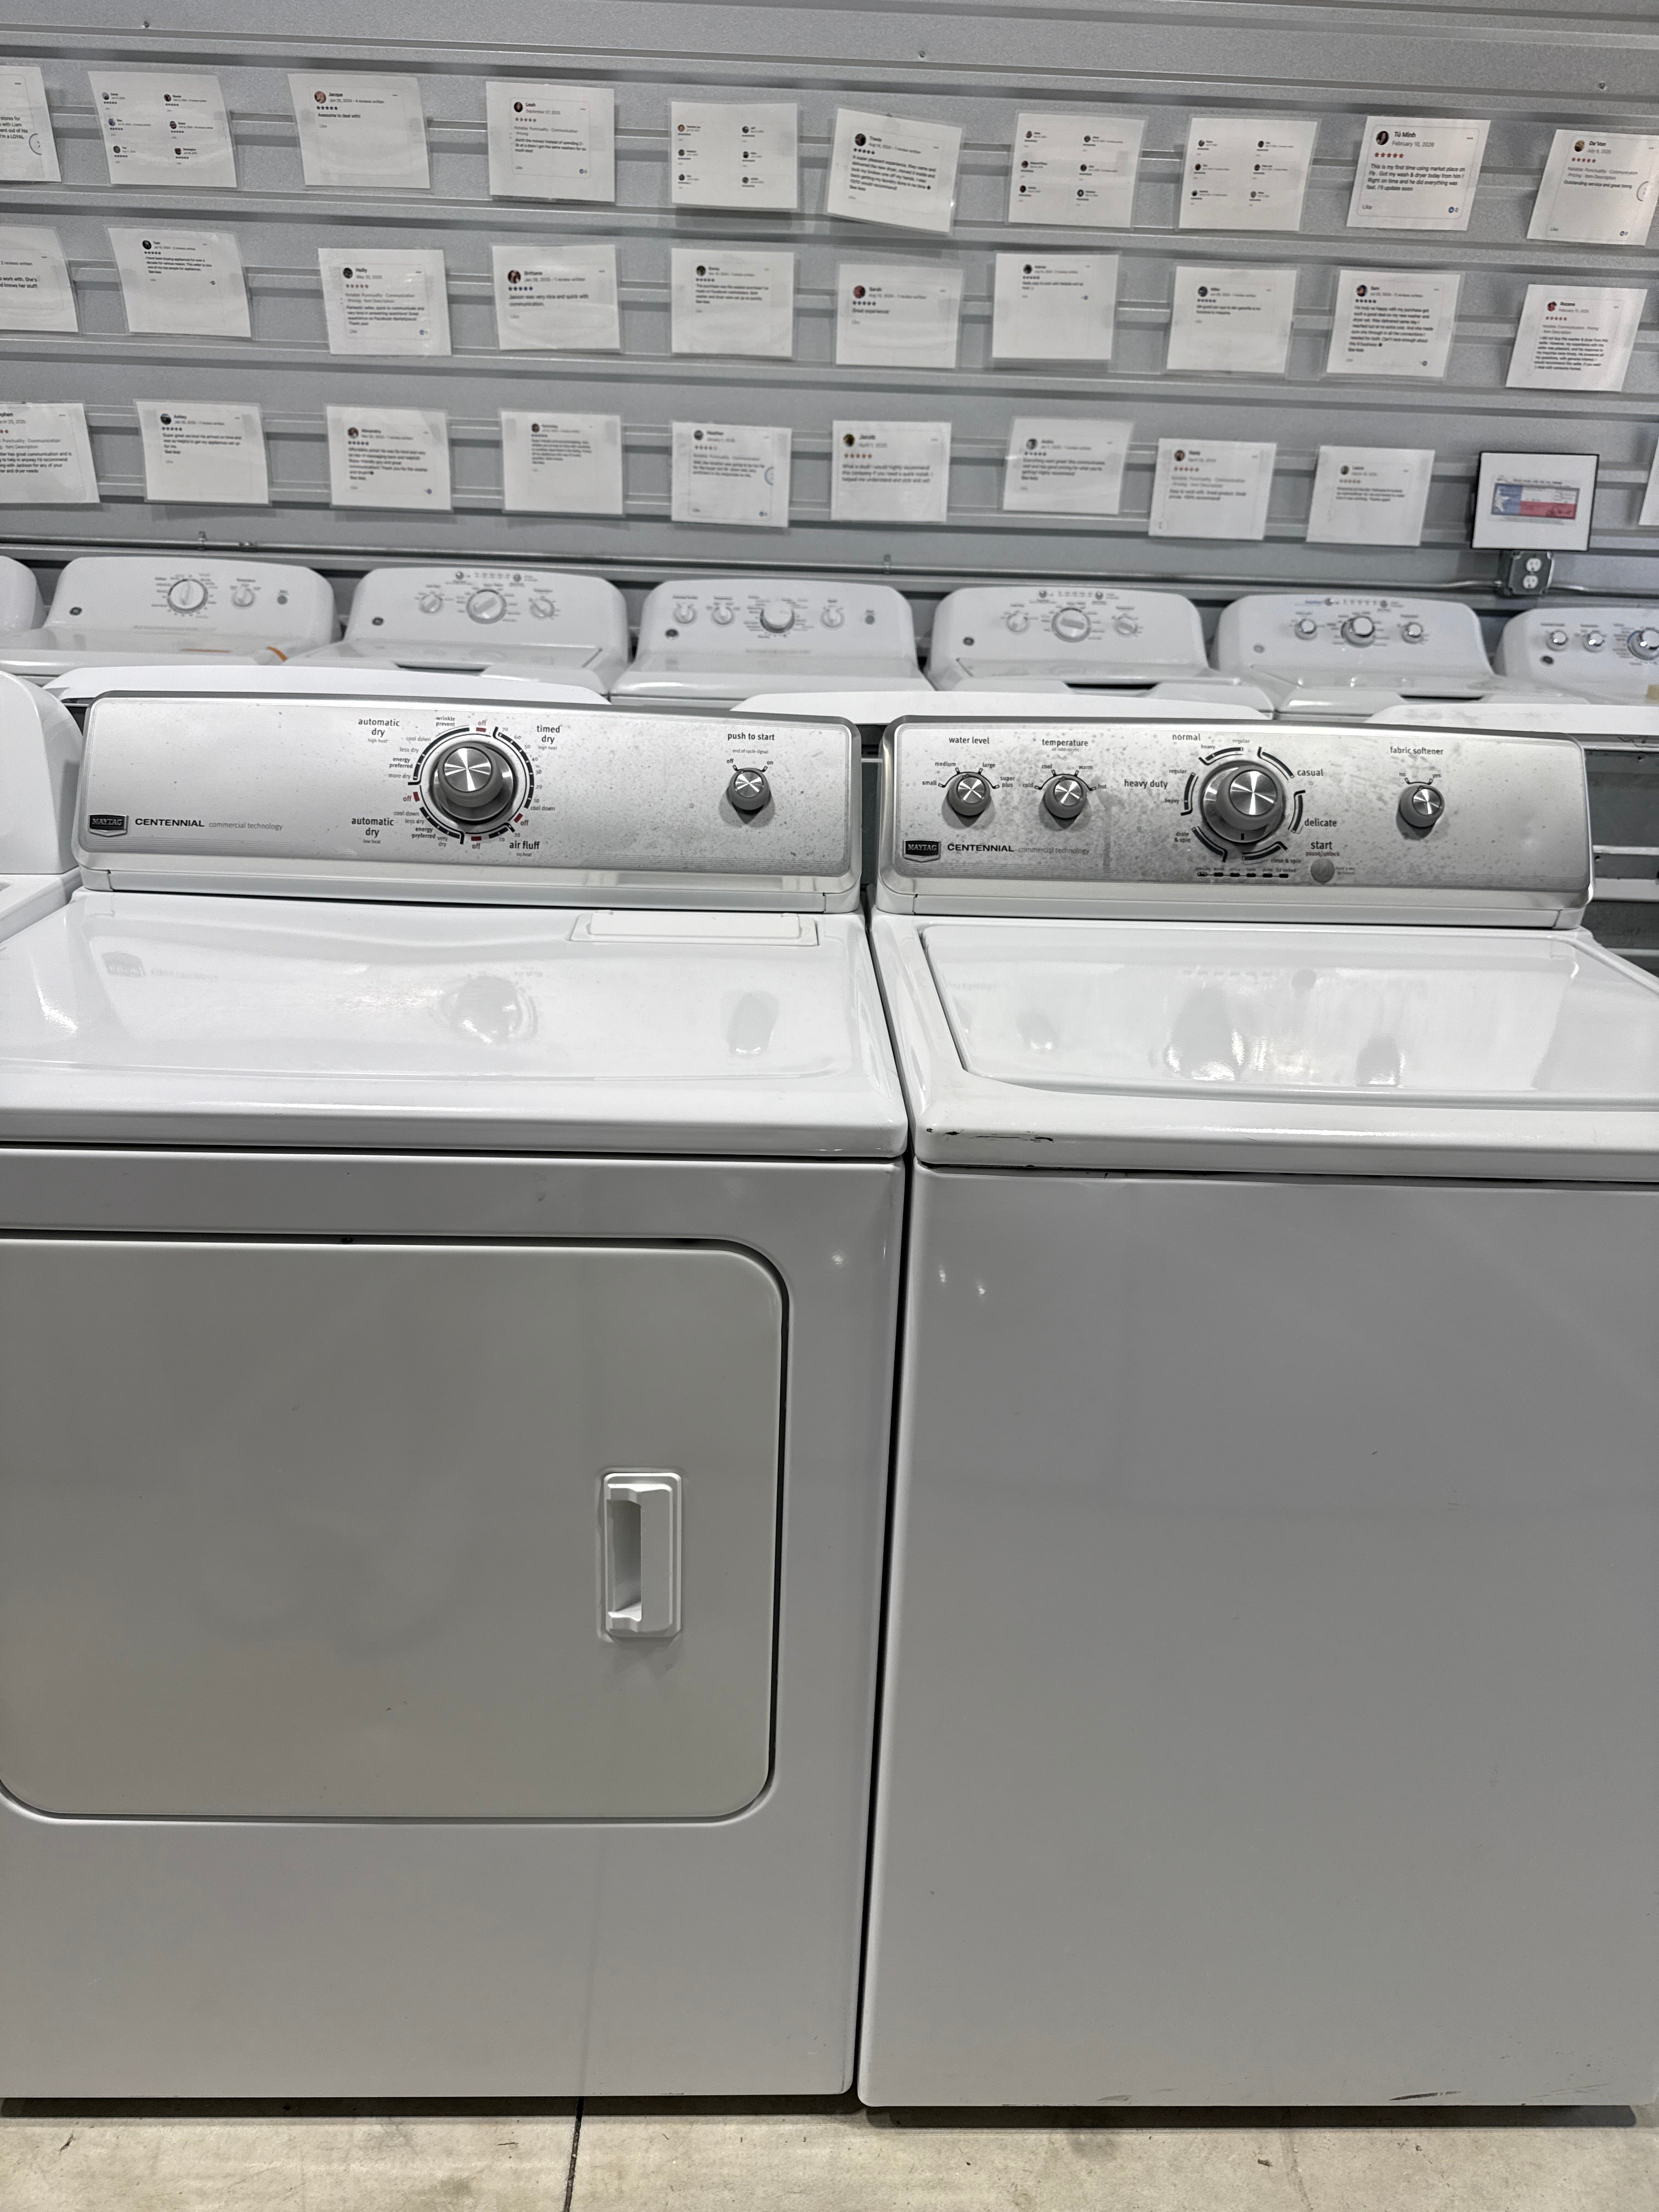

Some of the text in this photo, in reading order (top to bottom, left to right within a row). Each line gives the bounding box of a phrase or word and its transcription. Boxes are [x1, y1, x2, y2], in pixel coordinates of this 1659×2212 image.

[358, 719, 400, 727] automatic
[371, 728, 385, 737] dry
[537, 725, 561, 733] timed
[541, 735, 555, 744] dry
[728, 732, 746, 741] push
[972, 736, 990, 744] level
[1042, 739, 1088, 747] temperature
[1413, 747, 1444, 755] softener
[1297, 769, 1324, 777] casual
[1124, 779, 1168, 789] heavy duty
[92, 817, 123, 826] MAYTAG
[135, 818, 205, 827] CENTENNIAL
[247, 822, 283, 831] technology
[351, 817, 394, 826] automatic
[1305, 818, 1337, 827] delicate
[365, 827, 380, 838] dry
[510, 840, 540, 850] air fluff
[947, 843, 1014, 852] CENTENNIAL
[1018, 846, 1054, 854] commercial
[1311, 841, 1333, 850] start
